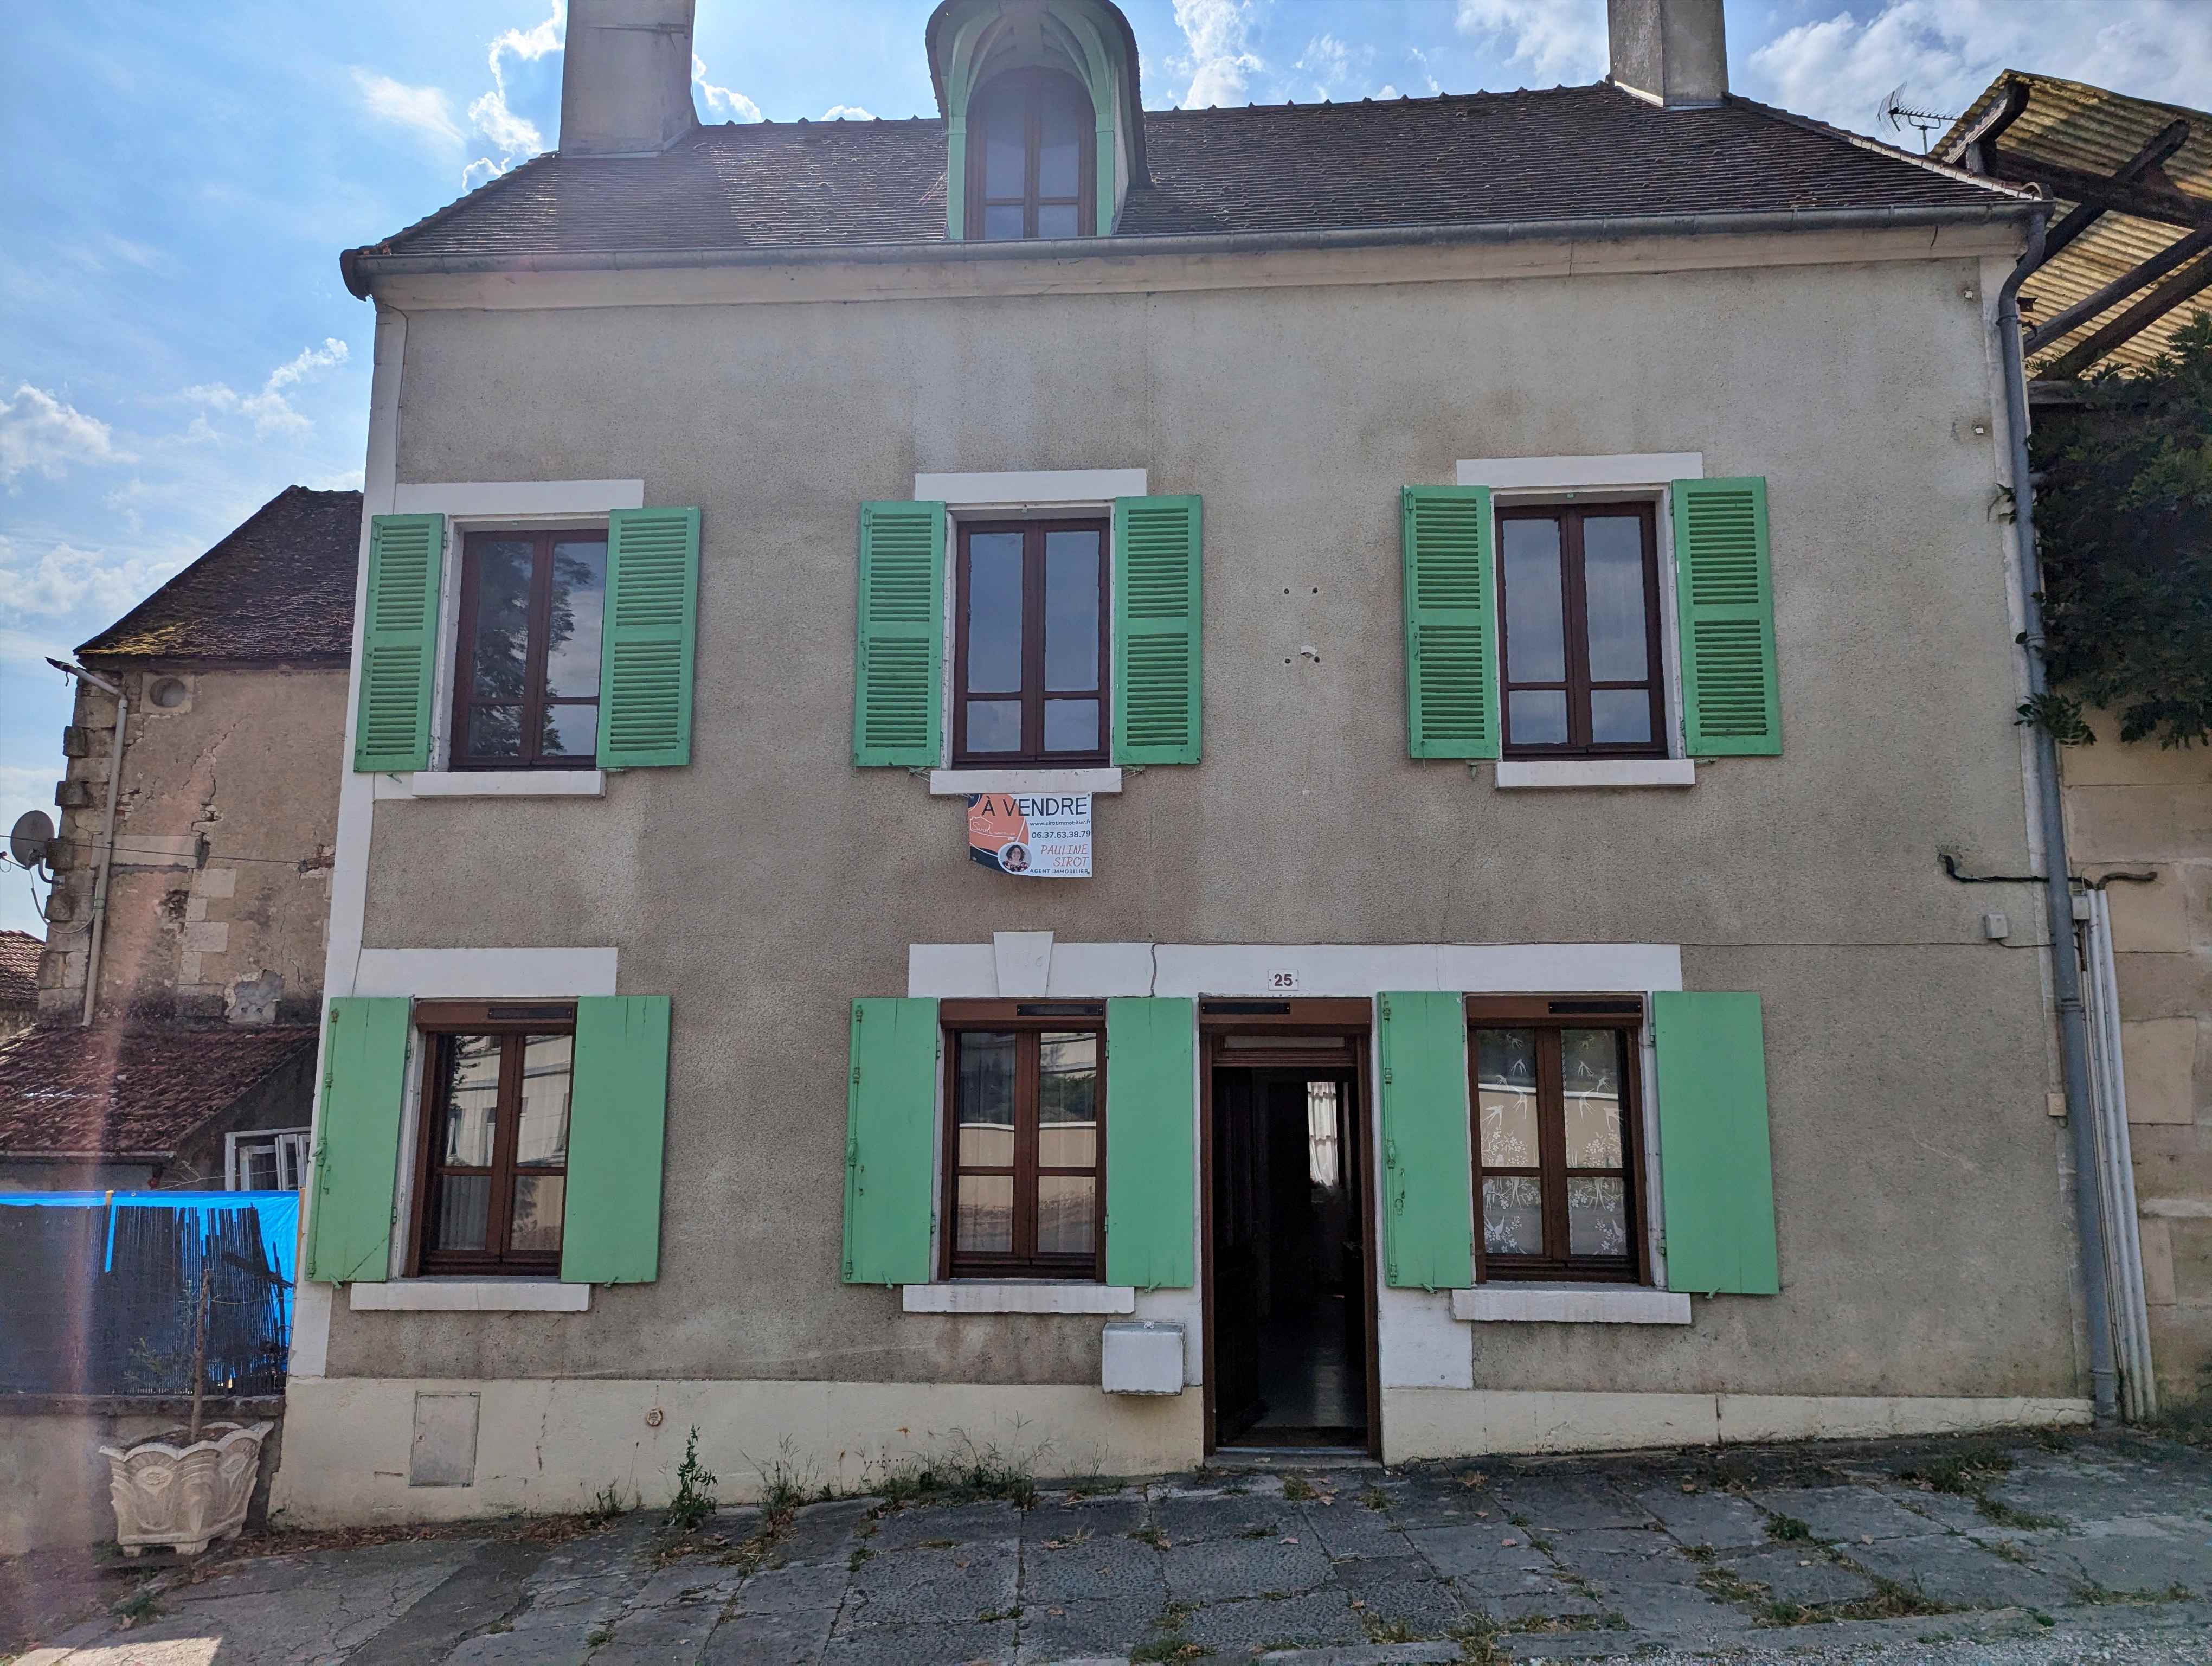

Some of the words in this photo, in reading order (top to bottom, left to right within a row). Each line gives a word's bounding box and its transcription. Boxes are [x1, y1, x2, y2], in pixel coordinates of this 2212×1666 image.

[981, 796, 995, 816] À
[1003, 797, 1087, 816] VENDRE
[1032, 830, 1091, 838] 06.37.63.38.79
[1041, 844, 1088, 855] PAULINE
[1053, 857, 1089, 867] SIROT
[1274, 973, 1293, 986] 25
